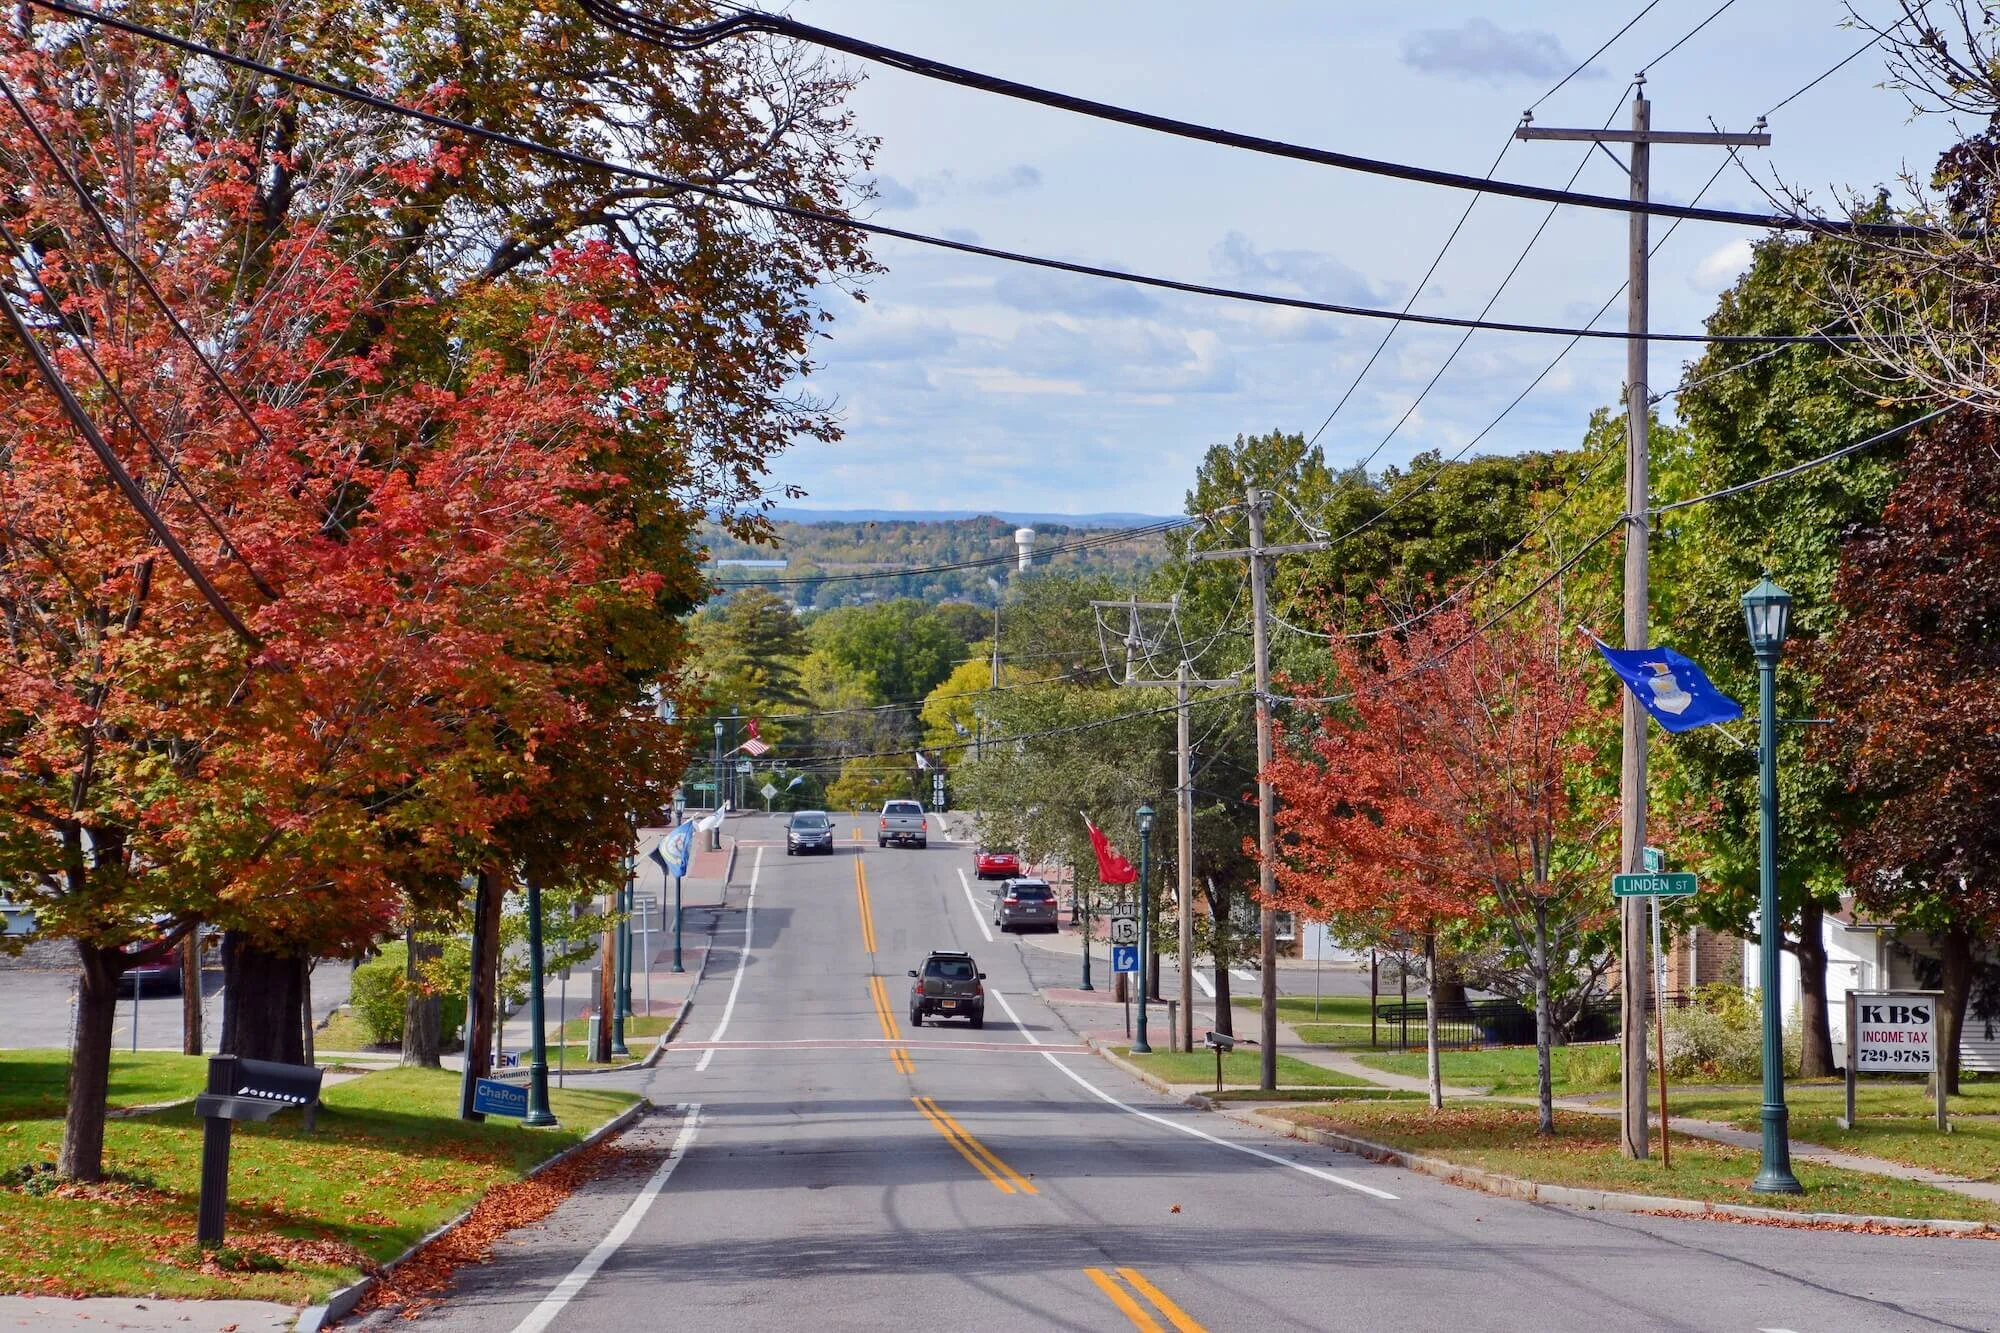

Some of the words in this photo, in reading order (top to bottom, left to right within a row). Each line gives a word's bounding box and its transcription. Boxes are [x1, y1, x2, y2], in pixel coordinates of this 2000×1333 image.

[1622, 879, 1669, 892] LINDEN
[1675, 880, 1688, 890] ST
[1116, 905, 1133, 915] JCT
[1118, 924, 1133, 938] 15
[1861, 1005, 1930, 1024] KBS
[1863, 1031, 1904, 1043] INCOME
[1907, 1032, 1928, 1043] TAX
[1861, 1049, 1930, 1063] 729-9785
[478, 1085, 525, 1102] ChaRon
